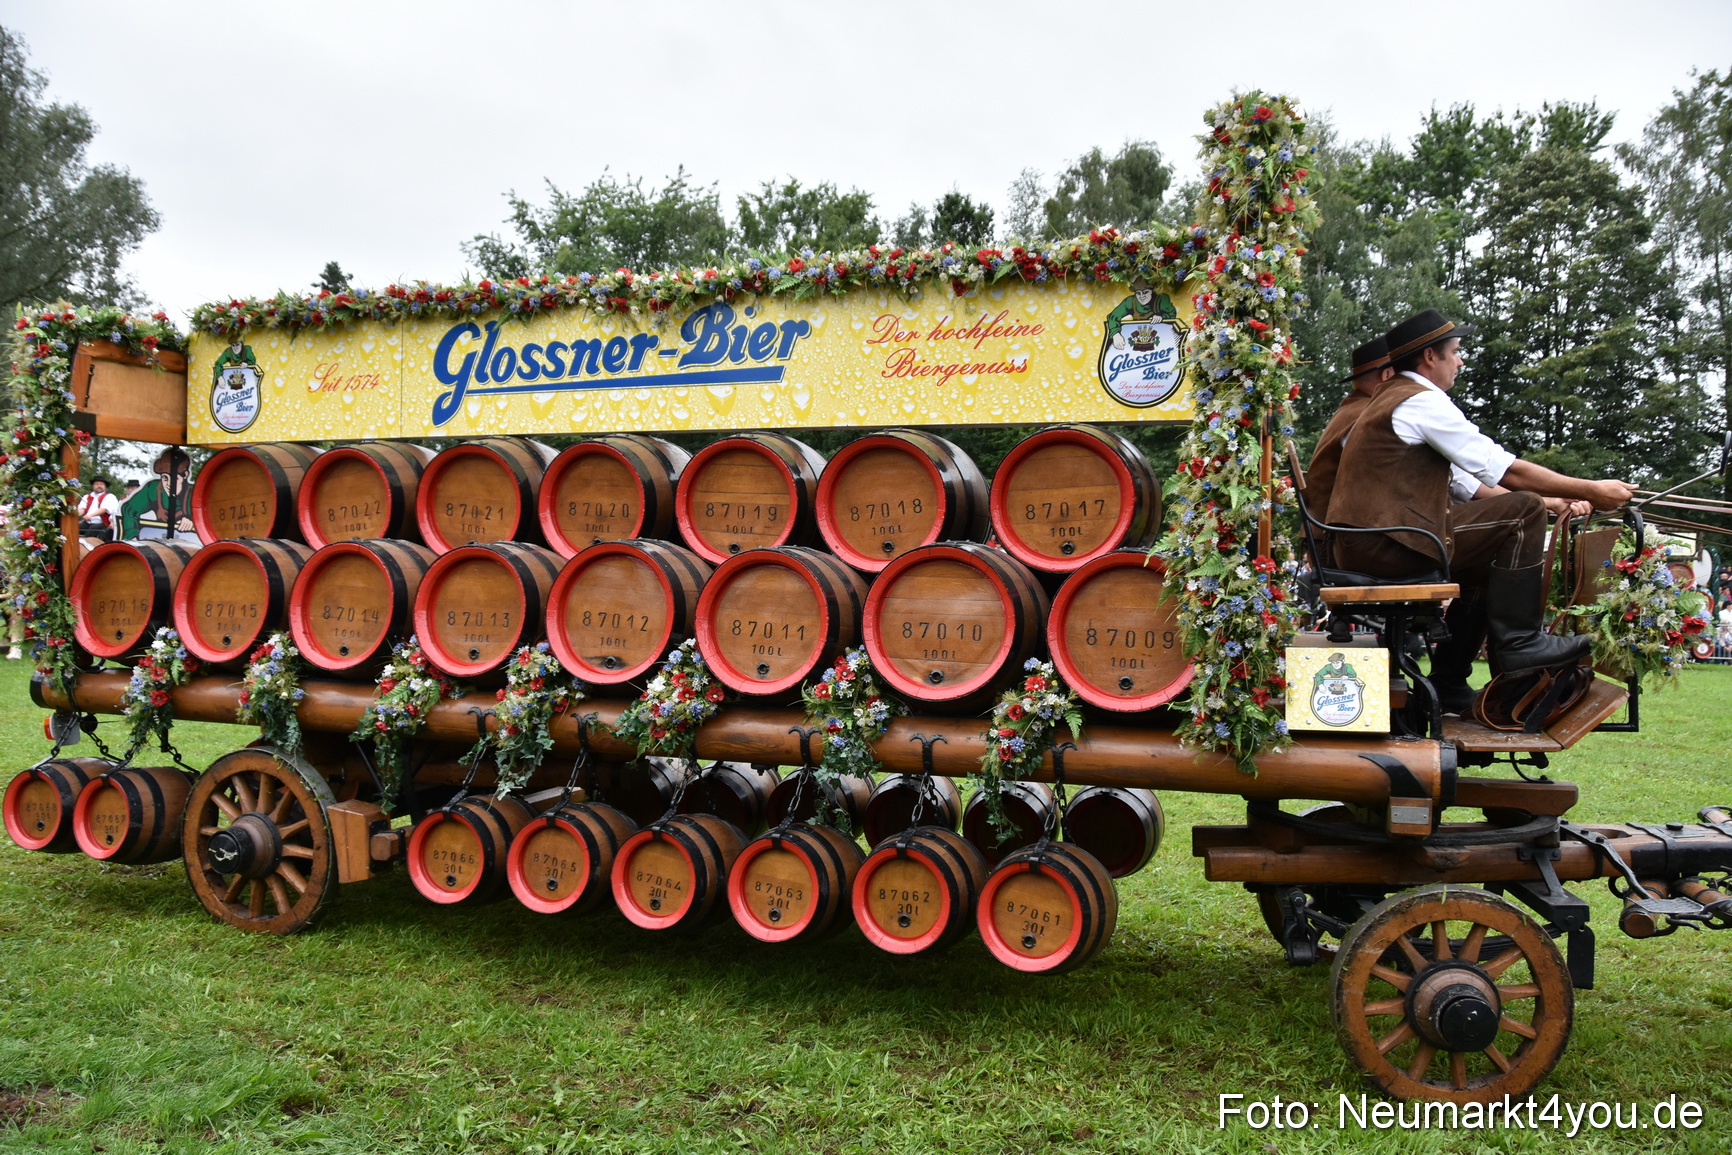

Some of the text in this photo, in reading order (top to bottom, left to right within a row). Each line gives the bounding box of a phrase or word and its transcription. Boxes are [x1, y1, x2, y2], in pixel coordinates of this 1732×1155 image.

[866, 309, 1045, 349] Der hochfeine
[432, 303, 812, 427] Glossner-Bier
[881, 347, 1027, 387] Biergenuss
[1109, 347, 1174, 382] Glossner
[1142, 366, 1172, 380] Bier
[308, 362, 381, 393] Seit 1574
[216, 387, 254, 413] Glossner
[236, 401, 254, 412] Bier
[328, 500, 381, 521] 87022
[446, 503, 504, 520] 87021
[568, 502, 629, 518] 87020
[706, 503, 777, 521] 87019
[851, 498, 923, 522] 87018
[1026, 499, 1105, 520] 87017
[100, 599, 149, 614] 87016
[205, 603, 257, 618] 87015
[322, 605, 379, 624] 87014
[447, 610, 510, 628] 87013
[582, 610, 649, 632] 87012
[732, 619, 804, 640] 87011
[902, 621, 982, 642] 87010
[1086, 628, 1174, 650] 87009
[1316, 693, 1356, 712] Glossner
[1337, 703, 1355, 712] Bier
[433, 850, 475, 865] 87066
[533, 853, 576, 873] 87065
[636, 871, 682, 892] 87064
[755, 881, 803, 901] 87063
[879, 889, 930, 903] 87062
[1007, 901, 1061, 926] 87061
